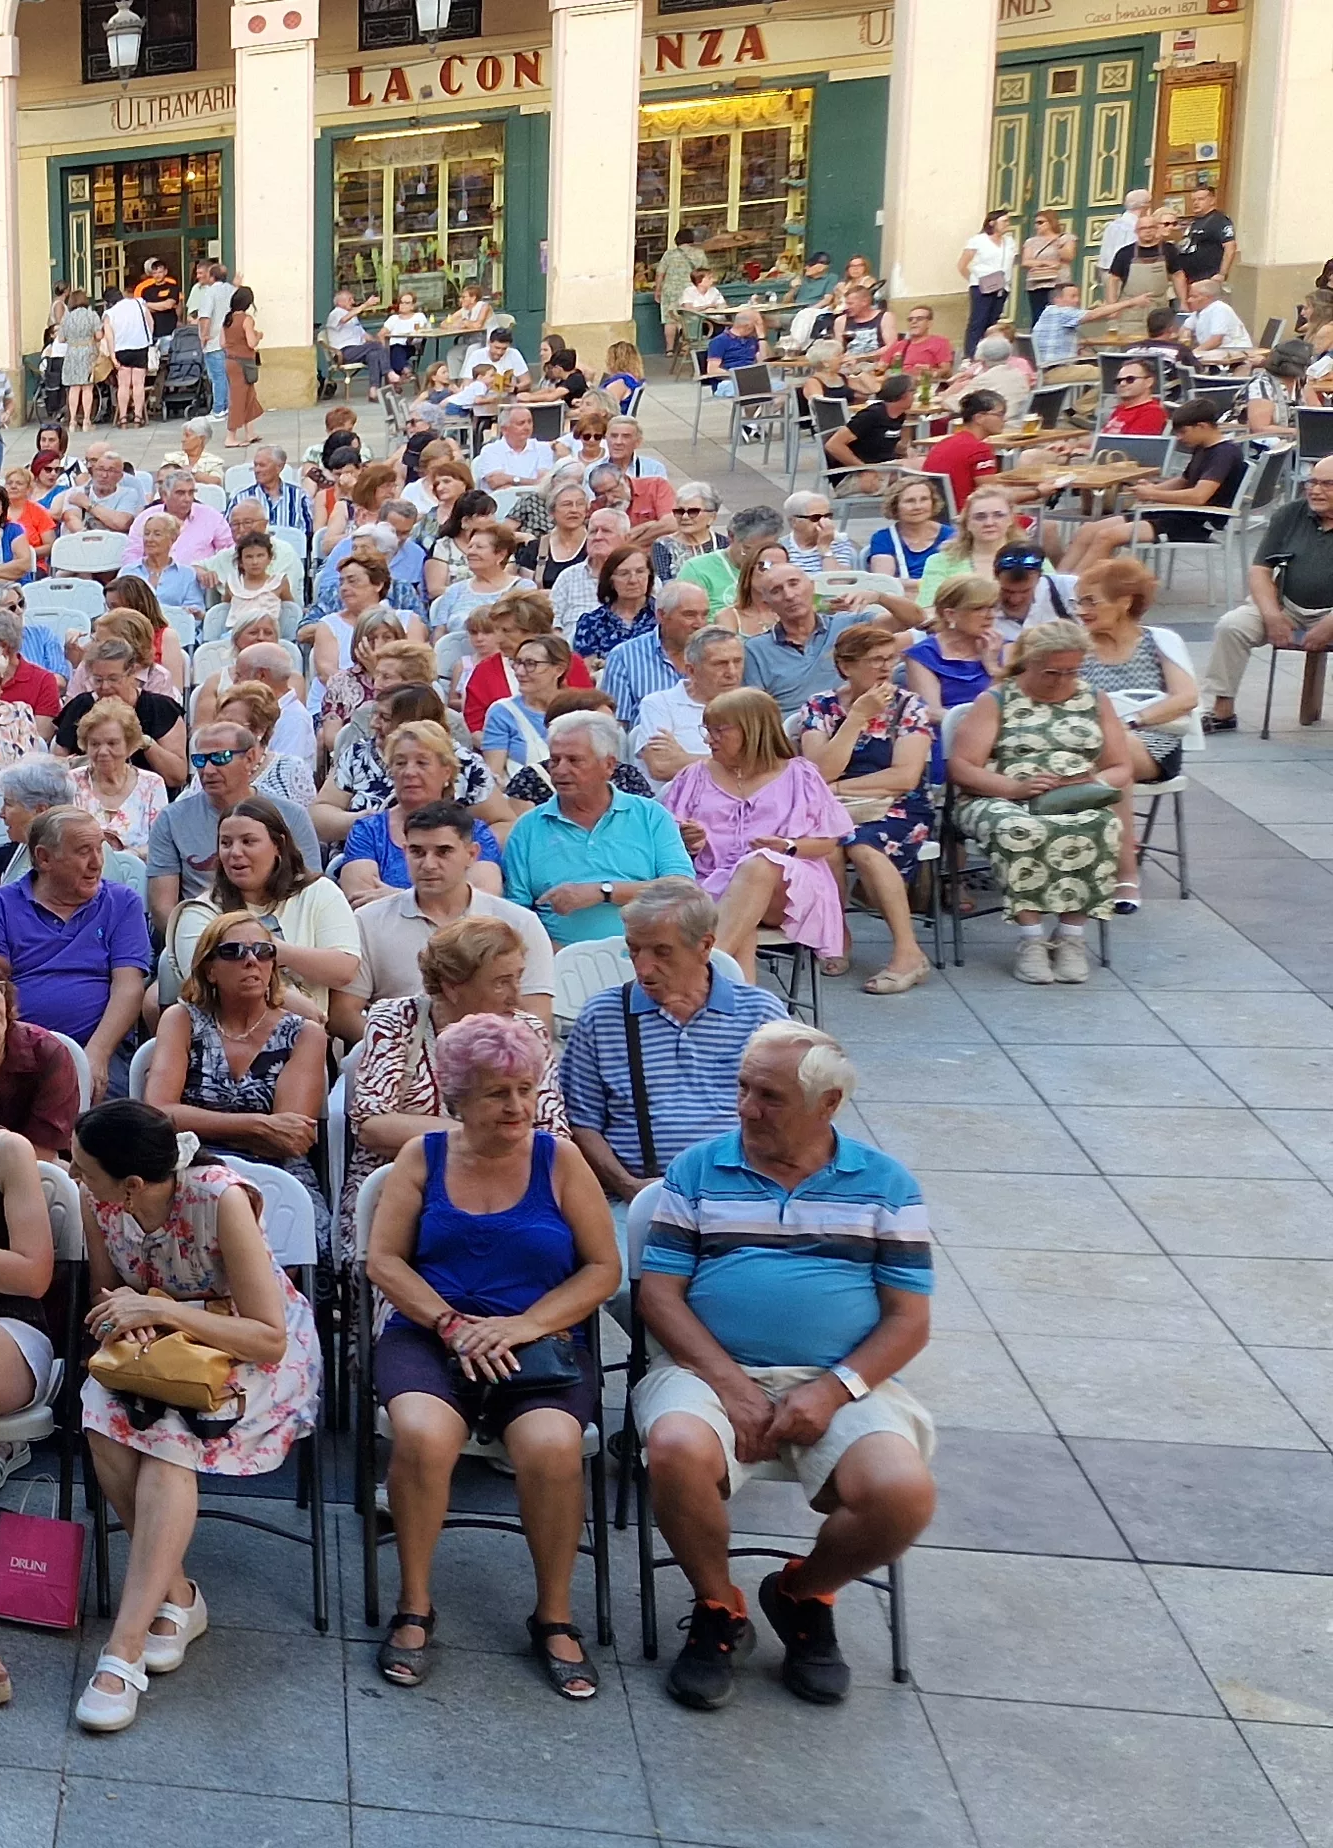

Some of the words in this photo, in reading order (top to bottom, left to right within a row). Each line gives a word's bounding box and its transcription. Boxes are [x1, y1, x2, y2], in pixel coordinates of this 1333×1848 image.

[1085, 12, 1111, 24] Casa
[1177, 2, 1198, 13] 1871
[347, 66, 413, 107] LA
[10, 1556, 48, 1573] DRUNI
